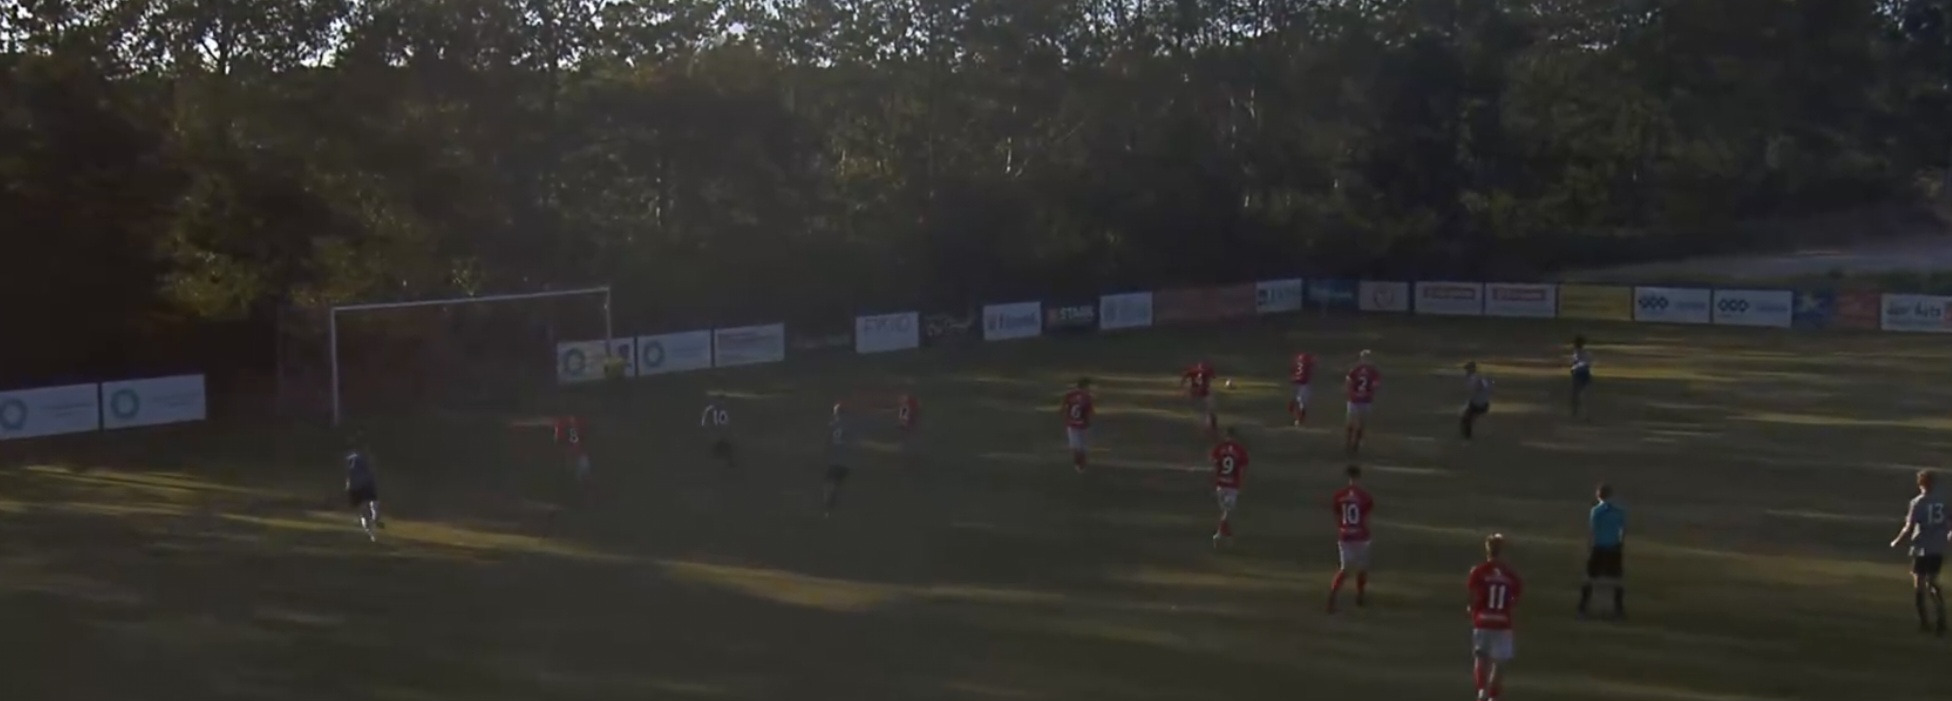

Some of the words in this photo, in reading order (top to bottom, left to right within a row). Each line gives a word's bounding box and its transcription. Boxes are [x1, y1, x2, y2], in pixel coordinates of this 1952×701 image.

[1357, 376, 1369, 392] 2
[712, 409, 729, 426] 10
[1070, 403, 1081, 419] 6
[1221, 455, 1235, 475] 9
[1341, 502, 1360, 526] 10
[1927, 502, 1945, 524] 13
[1488, 583, 1507, 610] 11
